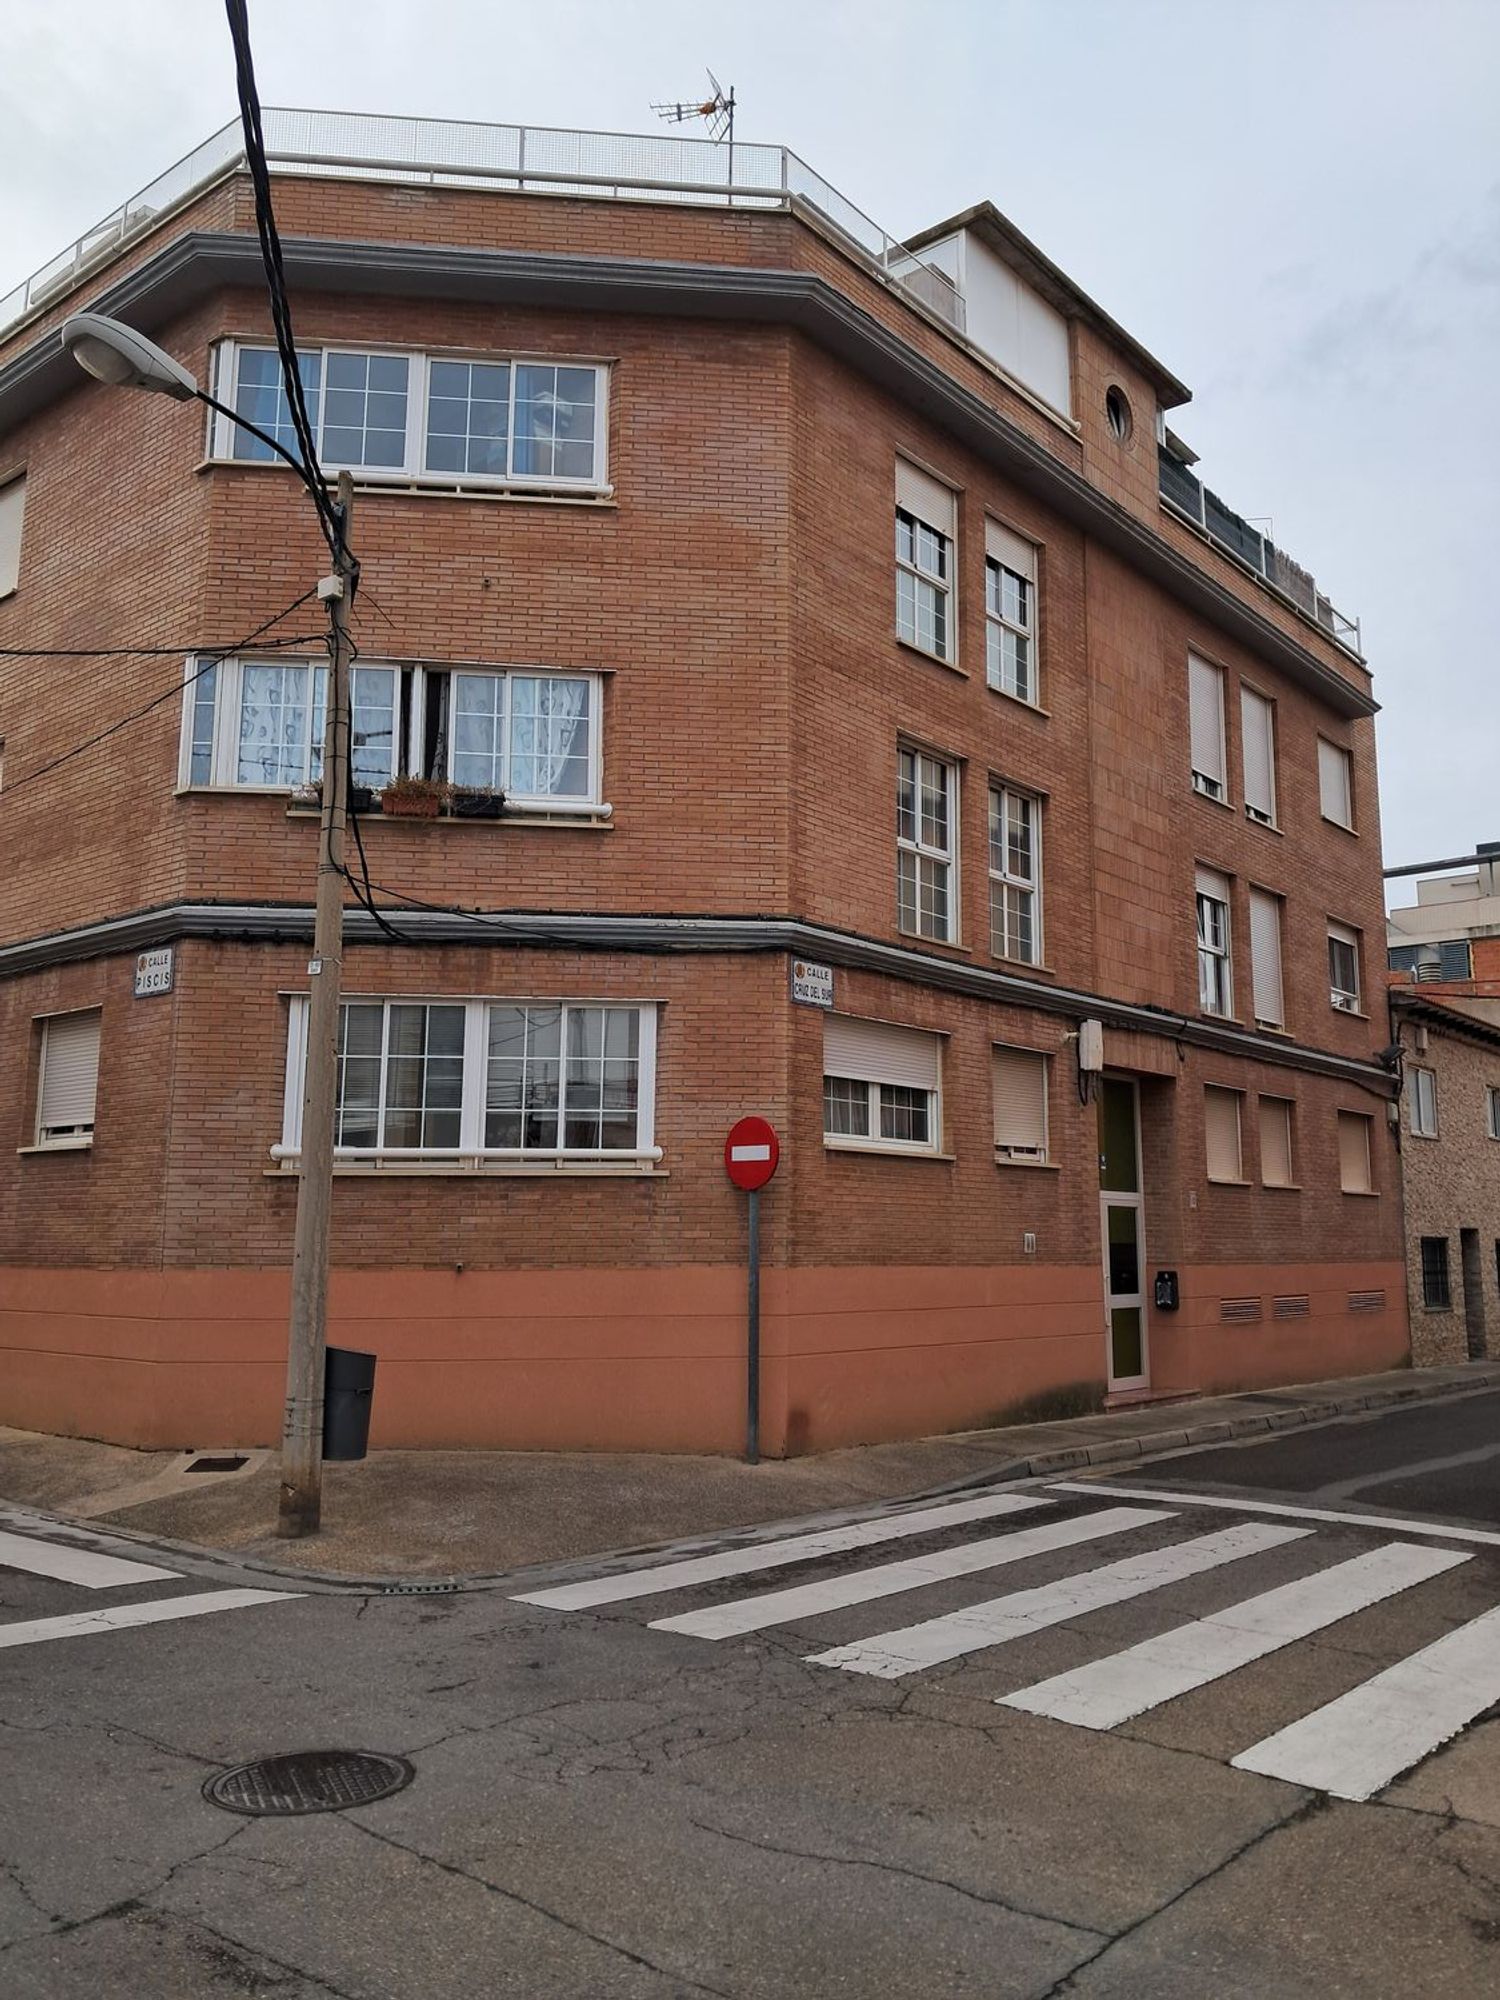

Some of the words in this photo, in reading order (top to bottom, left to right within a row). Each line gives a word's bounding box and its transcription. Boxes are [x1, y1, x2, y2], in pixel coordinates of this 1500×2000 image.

[148, 954, 168, 967] CALLE
[136, 972, 169, 988] PISCIS
[807, 967, 829, 981] CALLE
[795, 982, 809, 996] CRUZ
[810, 985, 820, 999] DEL
[821, 988, 832, 1001] SUR
